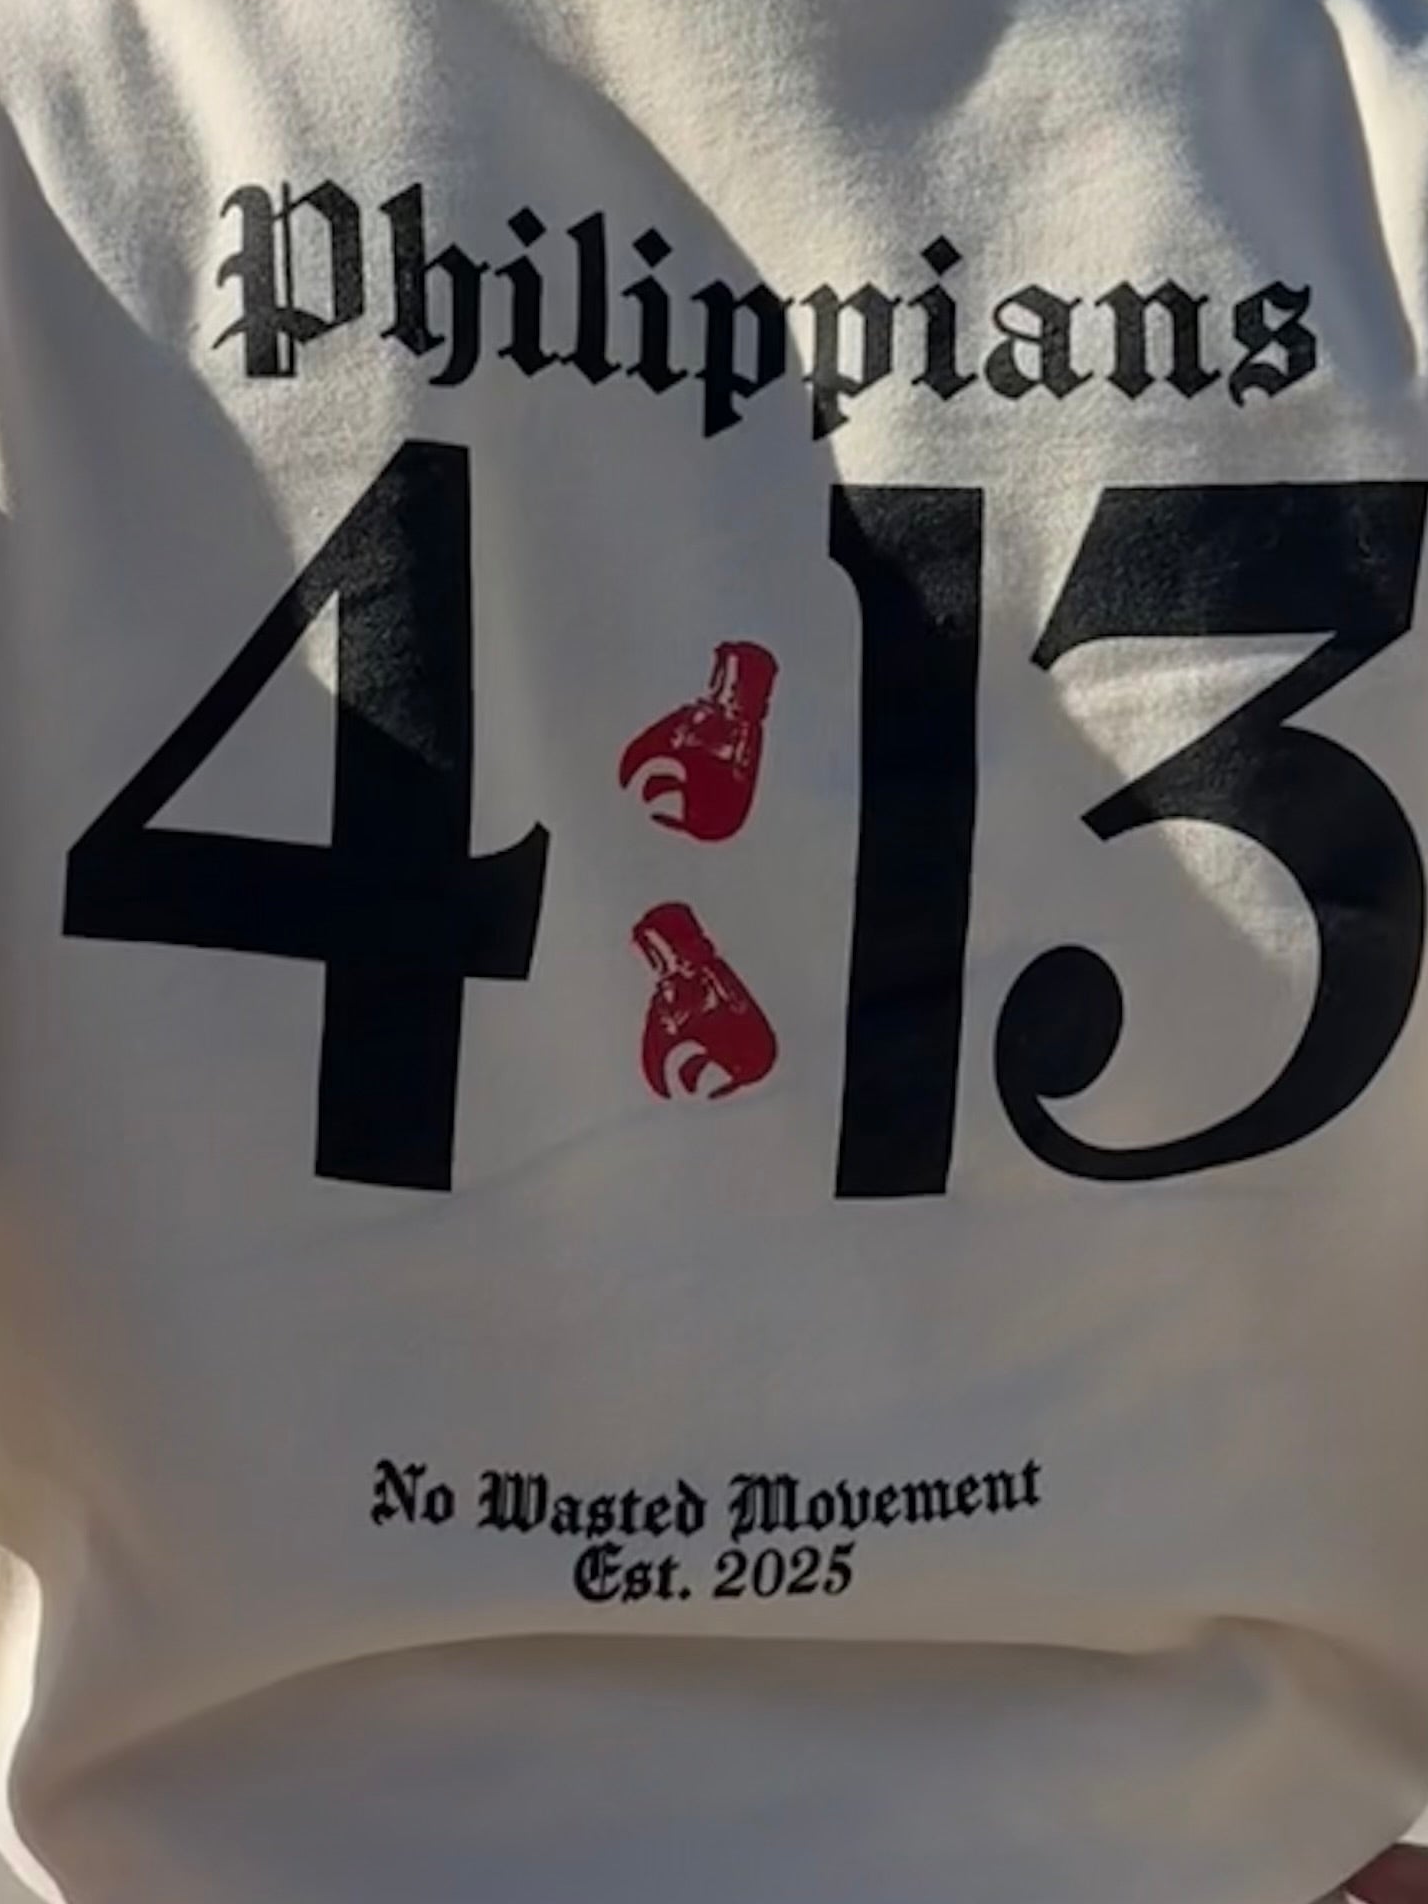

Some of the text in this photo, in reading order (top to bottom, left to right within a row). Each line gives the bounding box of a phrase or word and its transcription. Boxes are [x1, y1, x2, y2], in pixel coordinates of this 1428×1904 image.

[212, 178, 1319, 440] Philippians
[369, 1457, 1043, 1542] No Wasted Movement
[572, 1539, 856, 1604] Est. 2025
